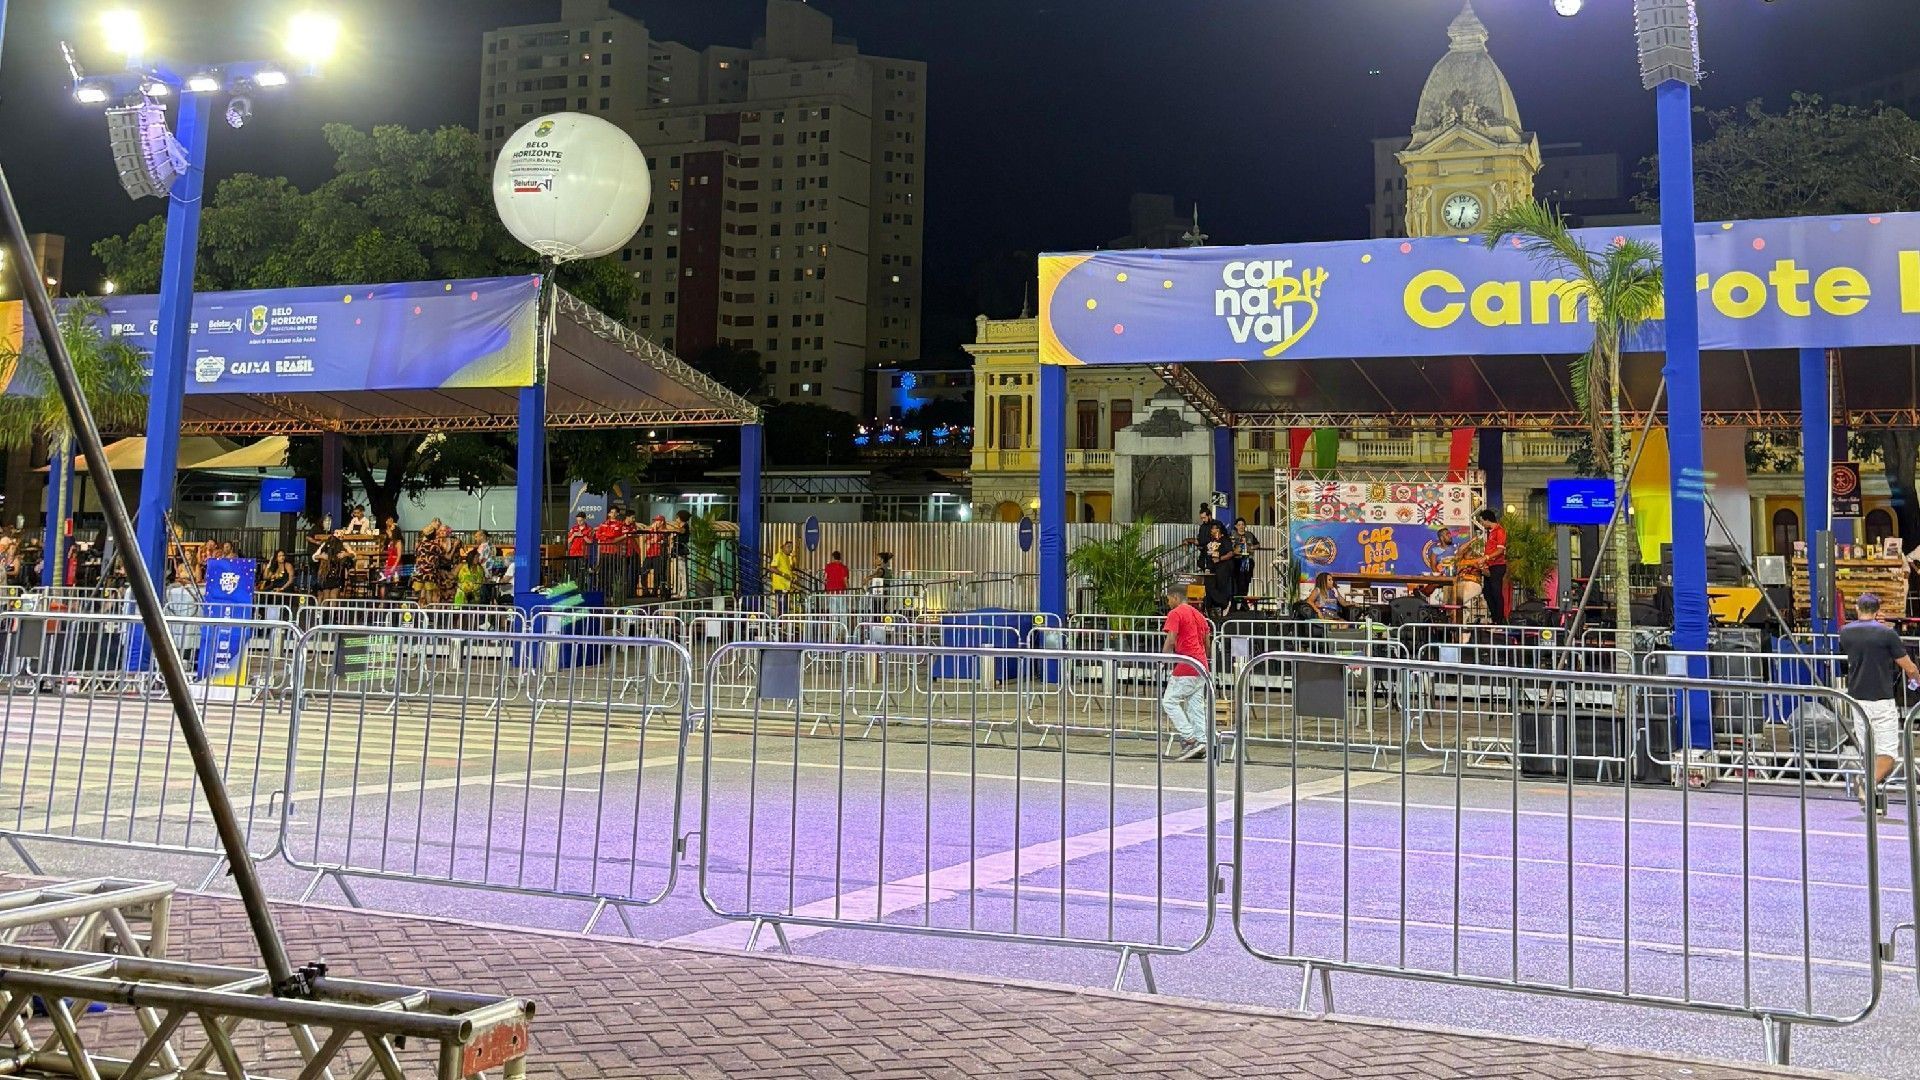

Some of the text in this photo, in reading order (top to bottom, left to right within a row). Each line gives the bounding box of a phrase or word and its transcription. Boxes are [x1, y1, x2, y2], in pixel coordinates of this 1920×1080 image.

[513, 150, 563, 158] HORIZONTE
[1223, 259, 1292, 288] car
[1215, 288, 1268, 315] na
[1403, 259, 1871, 329] Camote
[271, 316, 318, 326] HORIZONTE
[272, 307, 293, 316] BELO
[1226, 305, 1293, 343] val
[230, 360, 270, 375] CAIXA
[275, 359, 315, 373] BRASIL
[1357, 526, 1394, 545] CAR
[1364, 540, 1399, 565] NA
